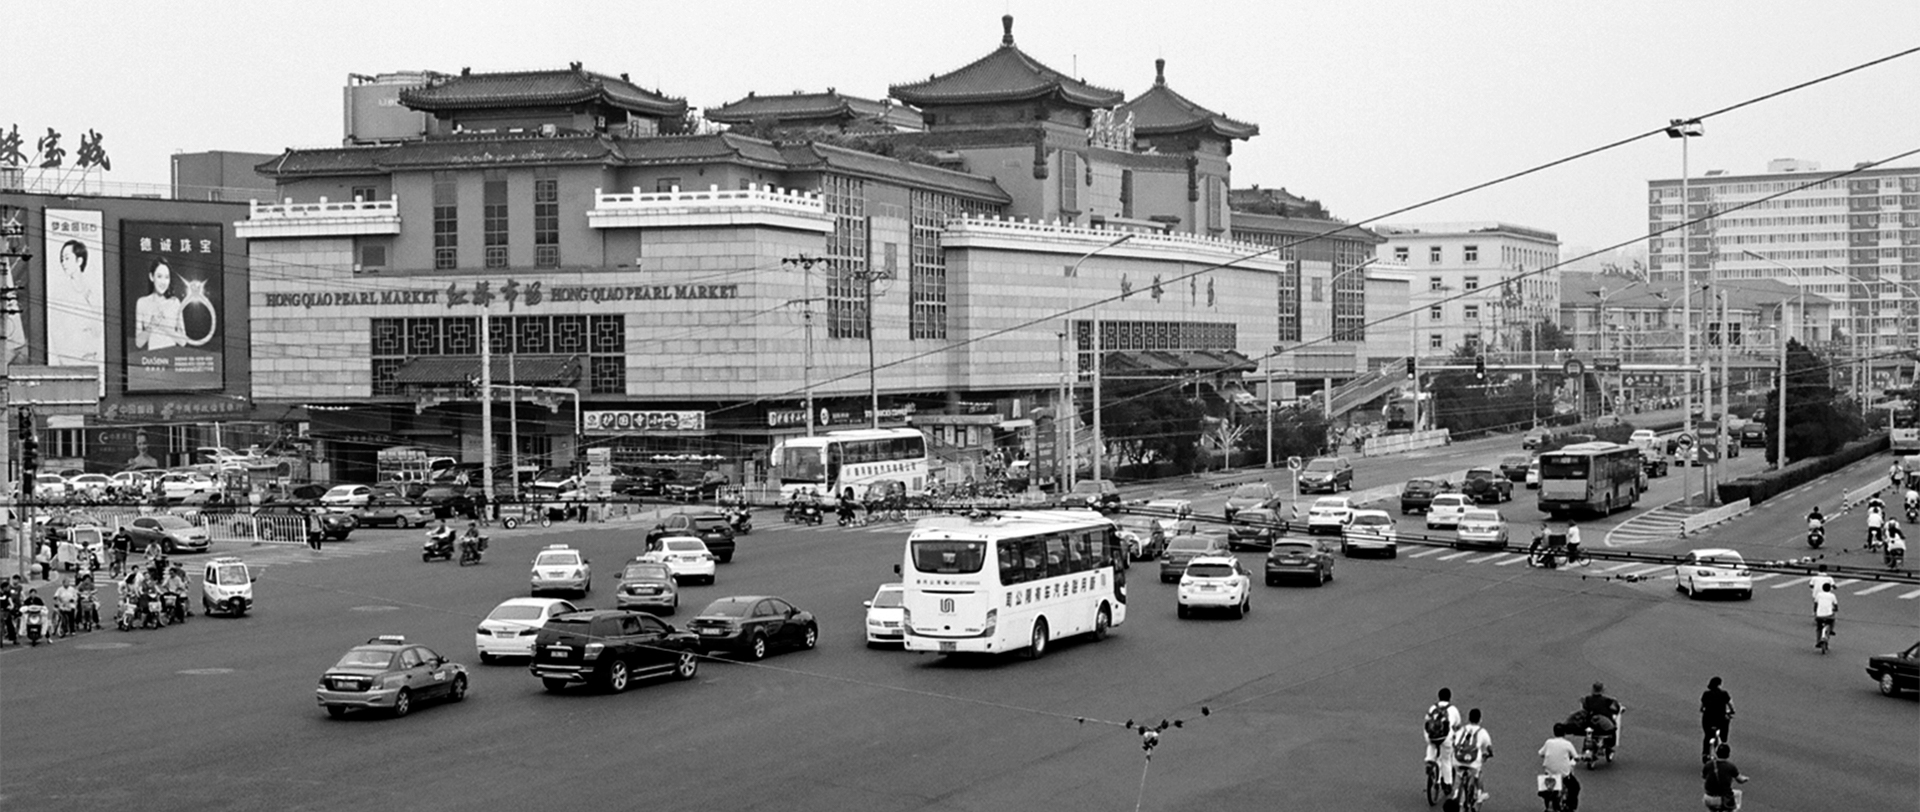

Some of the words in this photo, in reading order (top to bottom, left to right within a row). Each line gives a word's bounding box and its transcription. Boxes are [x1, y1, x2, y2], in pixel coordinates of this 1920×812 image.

[139, 237, 212, 254] 德诚珠宝
[265, 293, 301, 307] HONG
[302, 292, 333, 309] QIAO
[335, 291, 378, 306] PEARL
[380, 290, 438, 305] MARKET
[551, 287, 588, 302] HONG
[590, 286, 624, 304] QIAO
[626, 285, 672, 301] PEARL
[674, 284, 738, 300] MARKET
